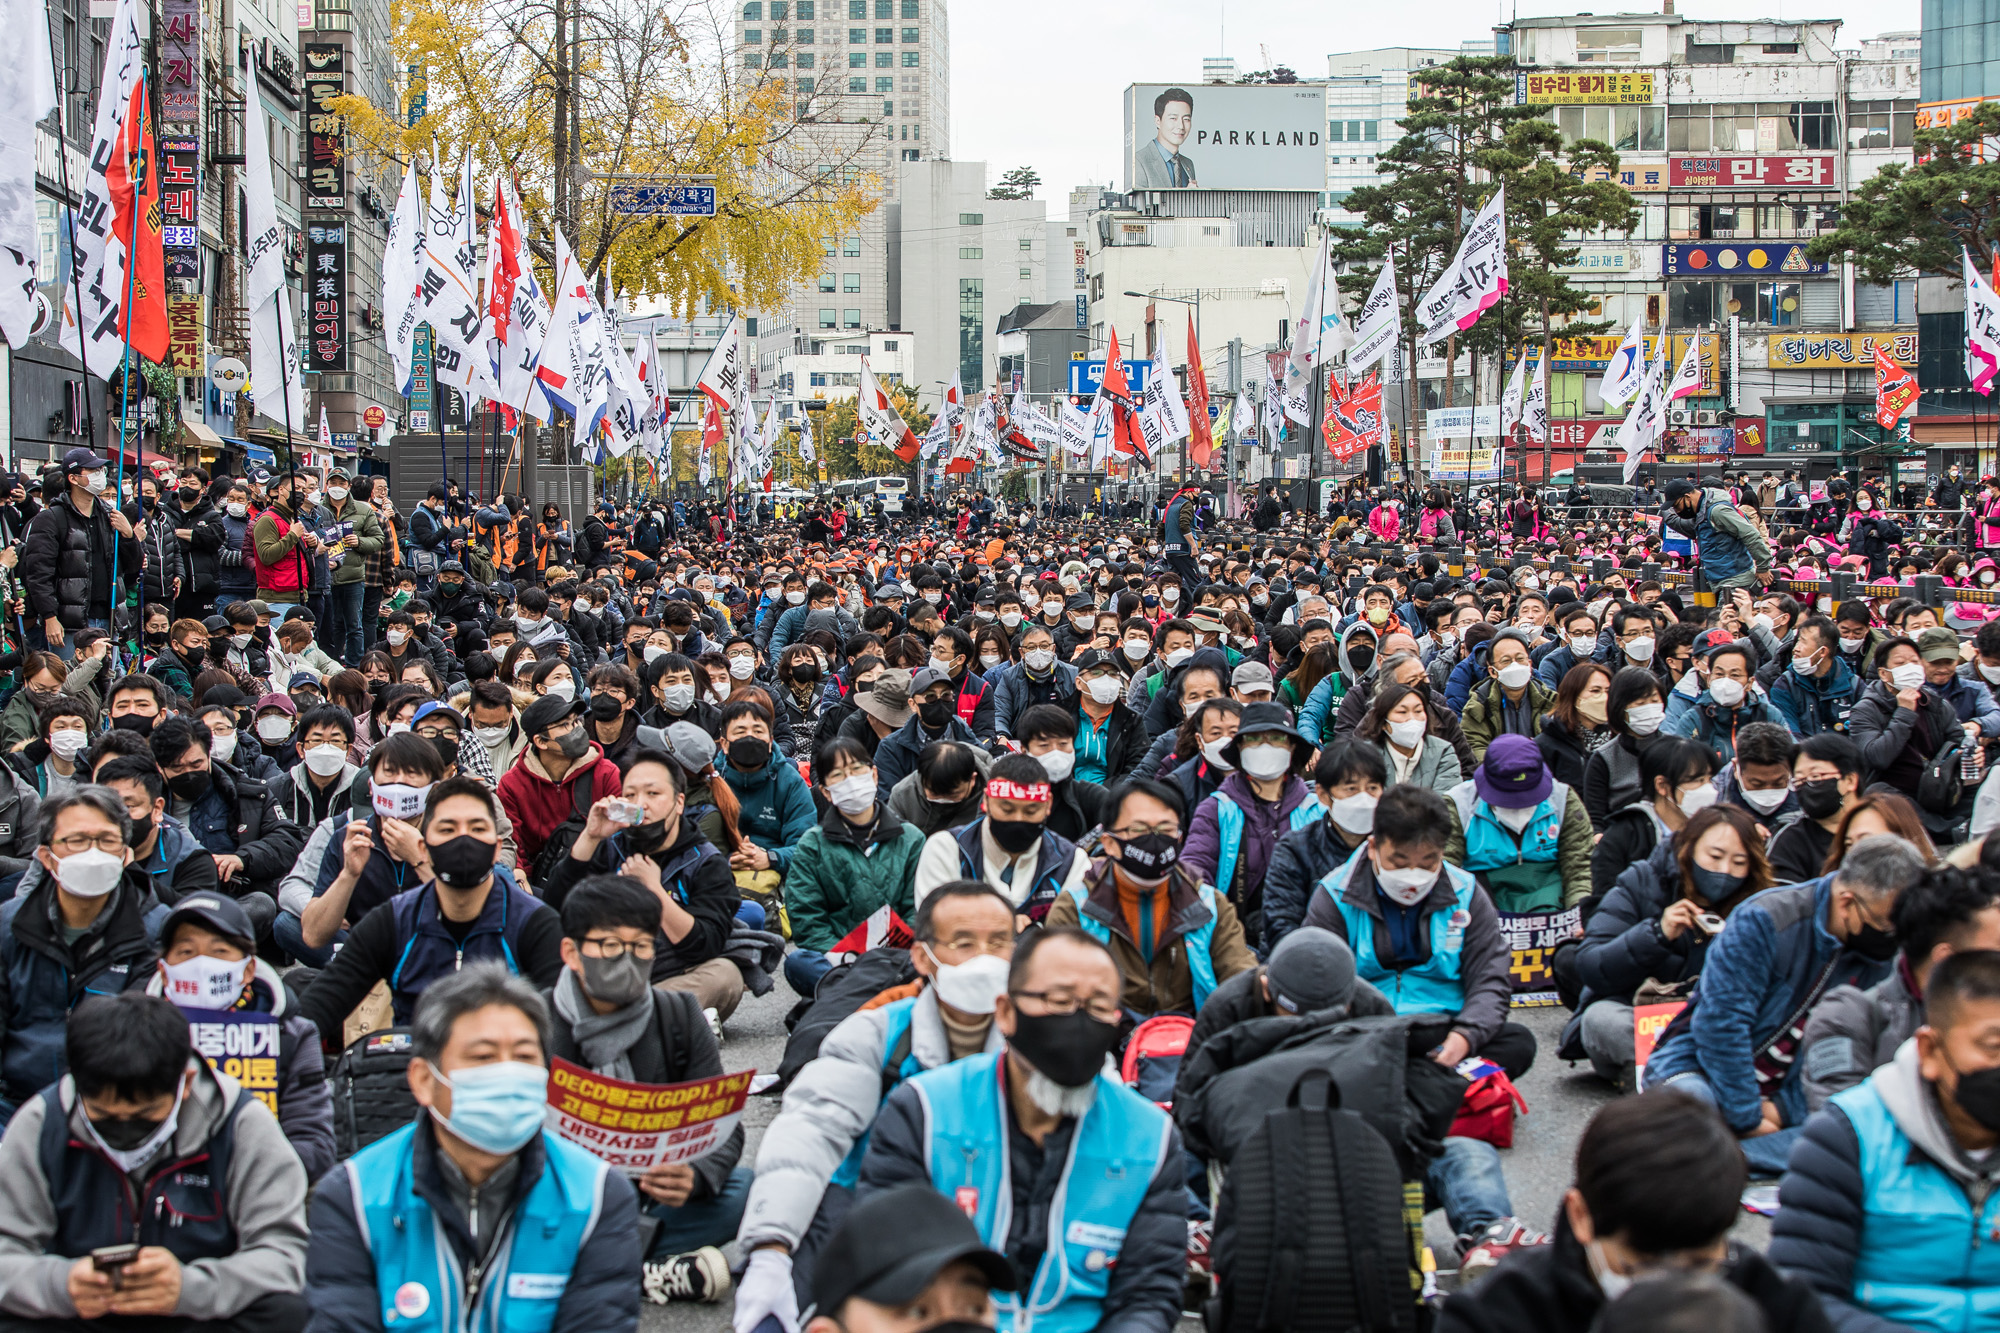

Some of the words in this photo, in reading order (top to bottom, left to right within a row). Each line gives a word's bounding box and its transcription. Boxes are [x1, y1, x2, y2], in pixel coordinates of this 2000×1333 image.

[164, 92, 198, 108] 24시
[1621, 94, 1651, 102] 인테리어
[1198, 130, 1319, 146] PARKLAND
[1681, 159, 1721, 172] 책천지
[1731, 158, 1827, 185] 만화
[163, 155, 196, 221] 노래
[164, 227, 195, 244] 광장
[309, 226, 345, 244] 동래
[315, 253, 339, 299] 東萊
[1811, 264, 1823, 272] 3F
[169, 302, 200, 370] 공인중개사
[858, 434, 866, 442] 50
